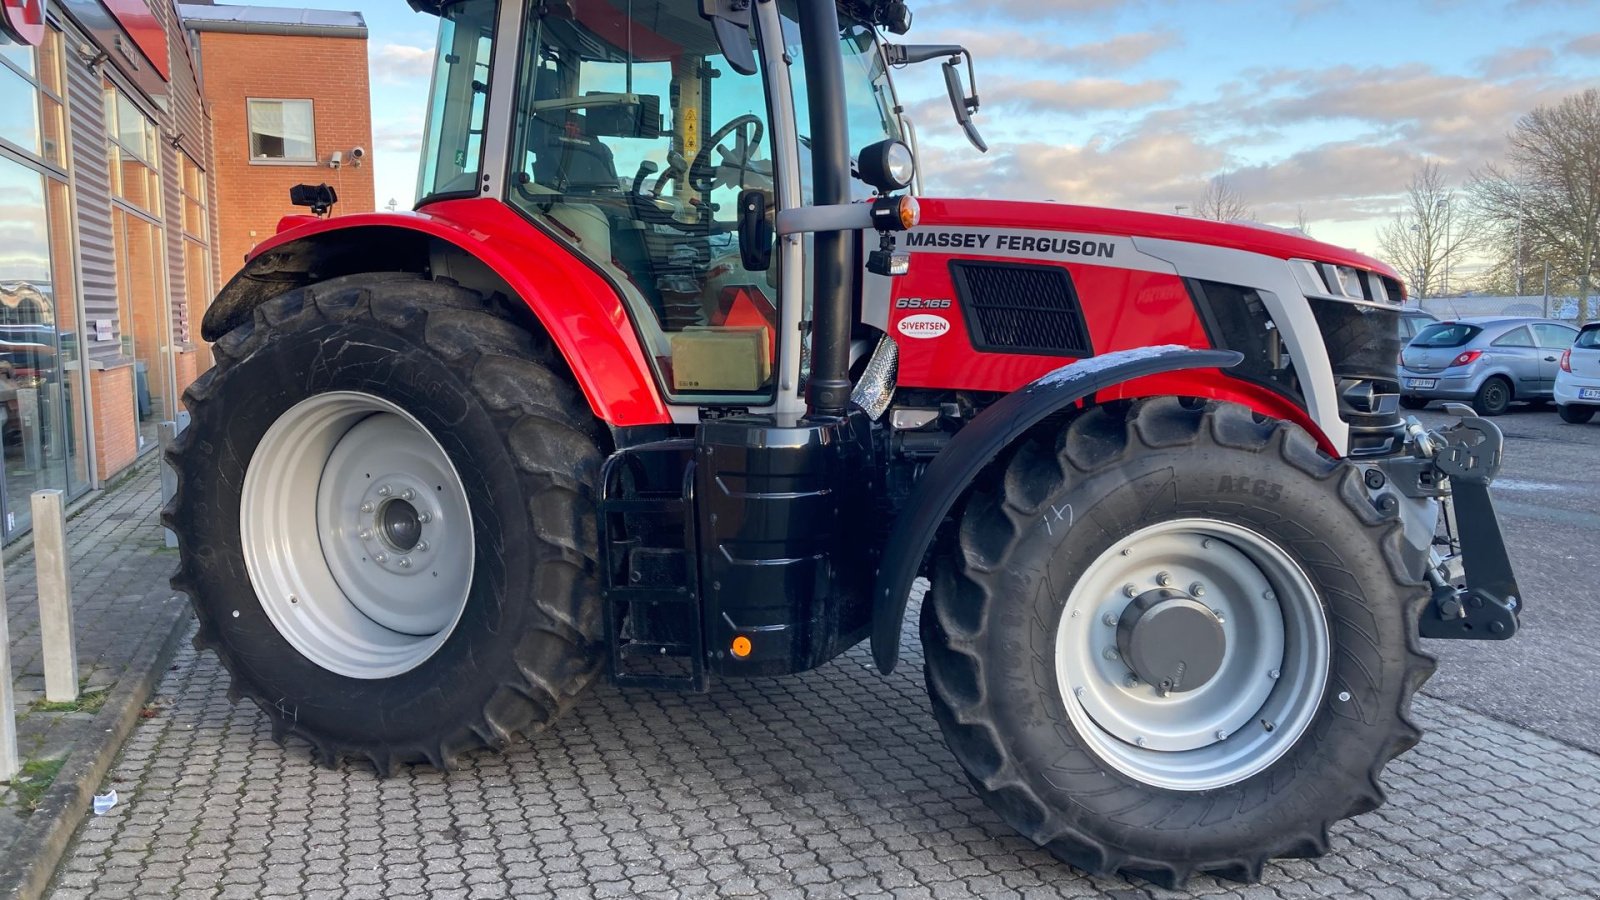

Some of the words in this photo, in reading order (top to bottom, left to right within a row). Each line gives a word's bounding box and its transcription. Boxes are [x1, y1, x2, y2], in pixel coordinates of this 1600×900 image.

[905, 232, 990, 249] MASSEY
[996, 235, 1116, 258] FERGUSON
[895, 297, 952, 309] 6S.165
[901, 321, 947, 330] SIVERTSEN
[1216, 474, 1285, 503] AC65
